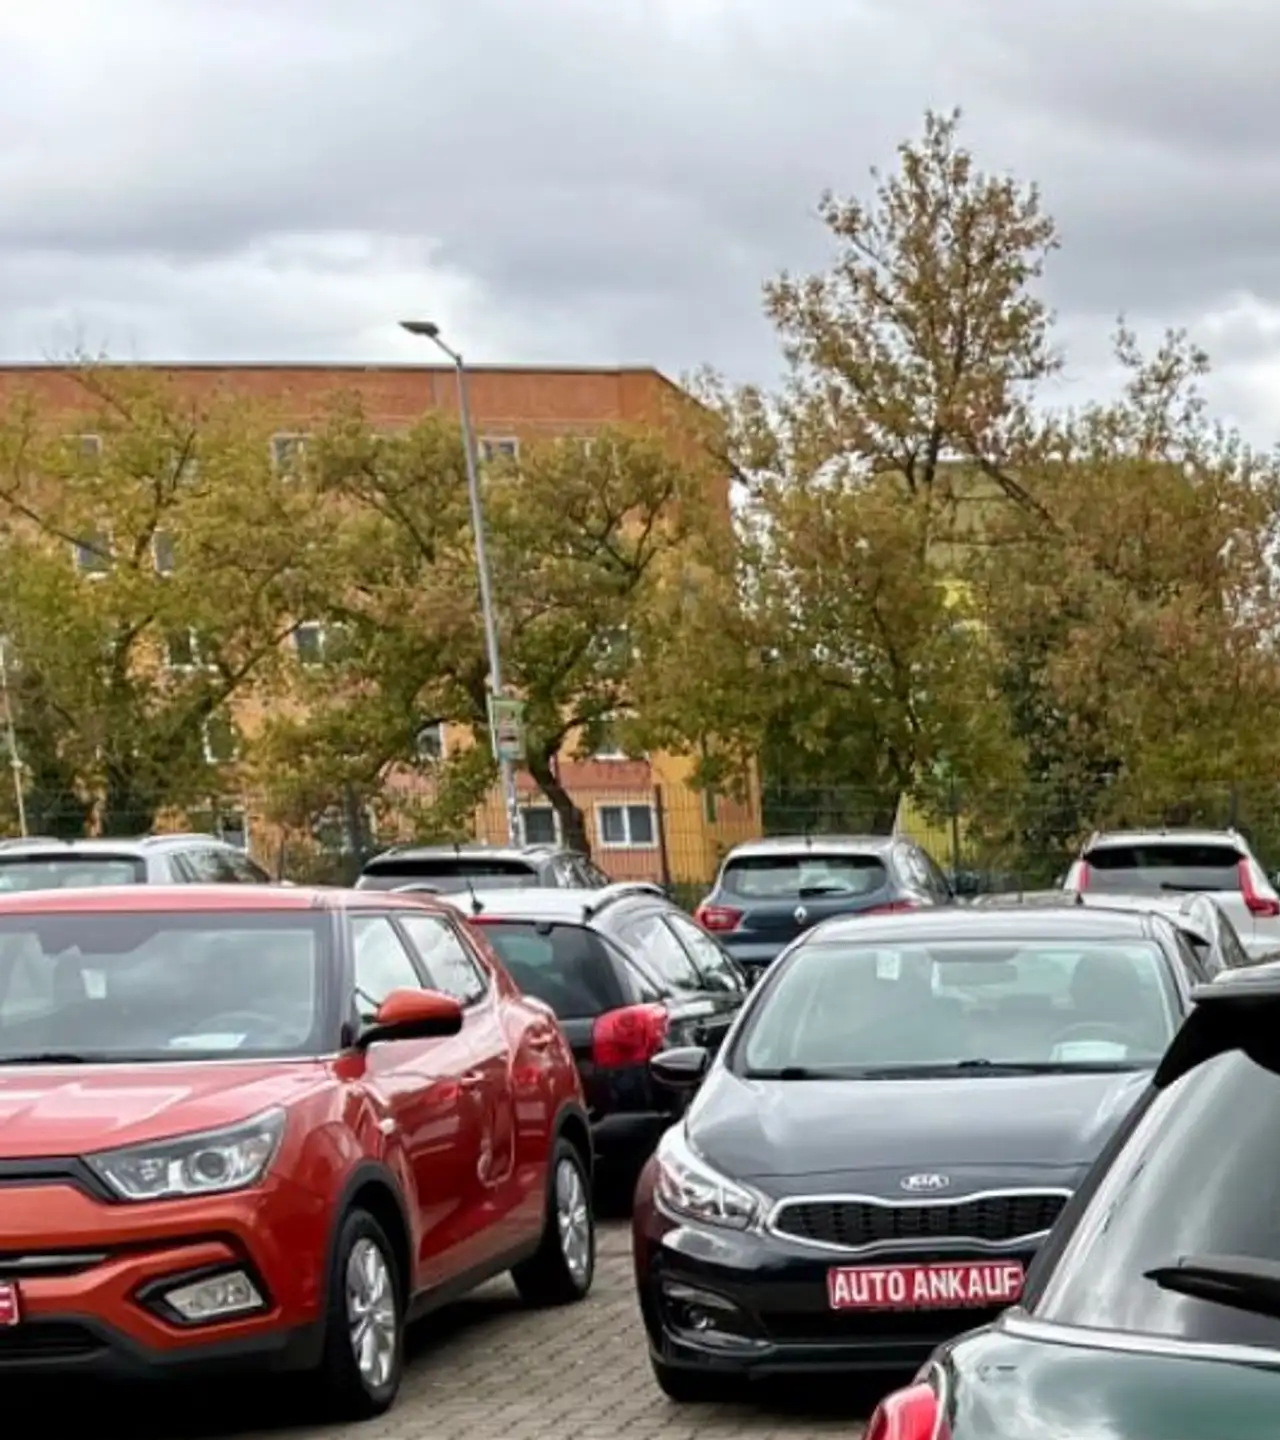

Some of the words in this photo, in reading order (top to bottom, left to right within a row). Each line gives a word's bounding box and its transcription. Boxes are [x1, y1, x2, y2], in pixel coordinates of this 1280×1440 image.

[909, 1173, 942, 1189] KIA
[834, 1270, 906, 1304] AUTO
[913, 1265, 1021, 1301] ANKAUF
